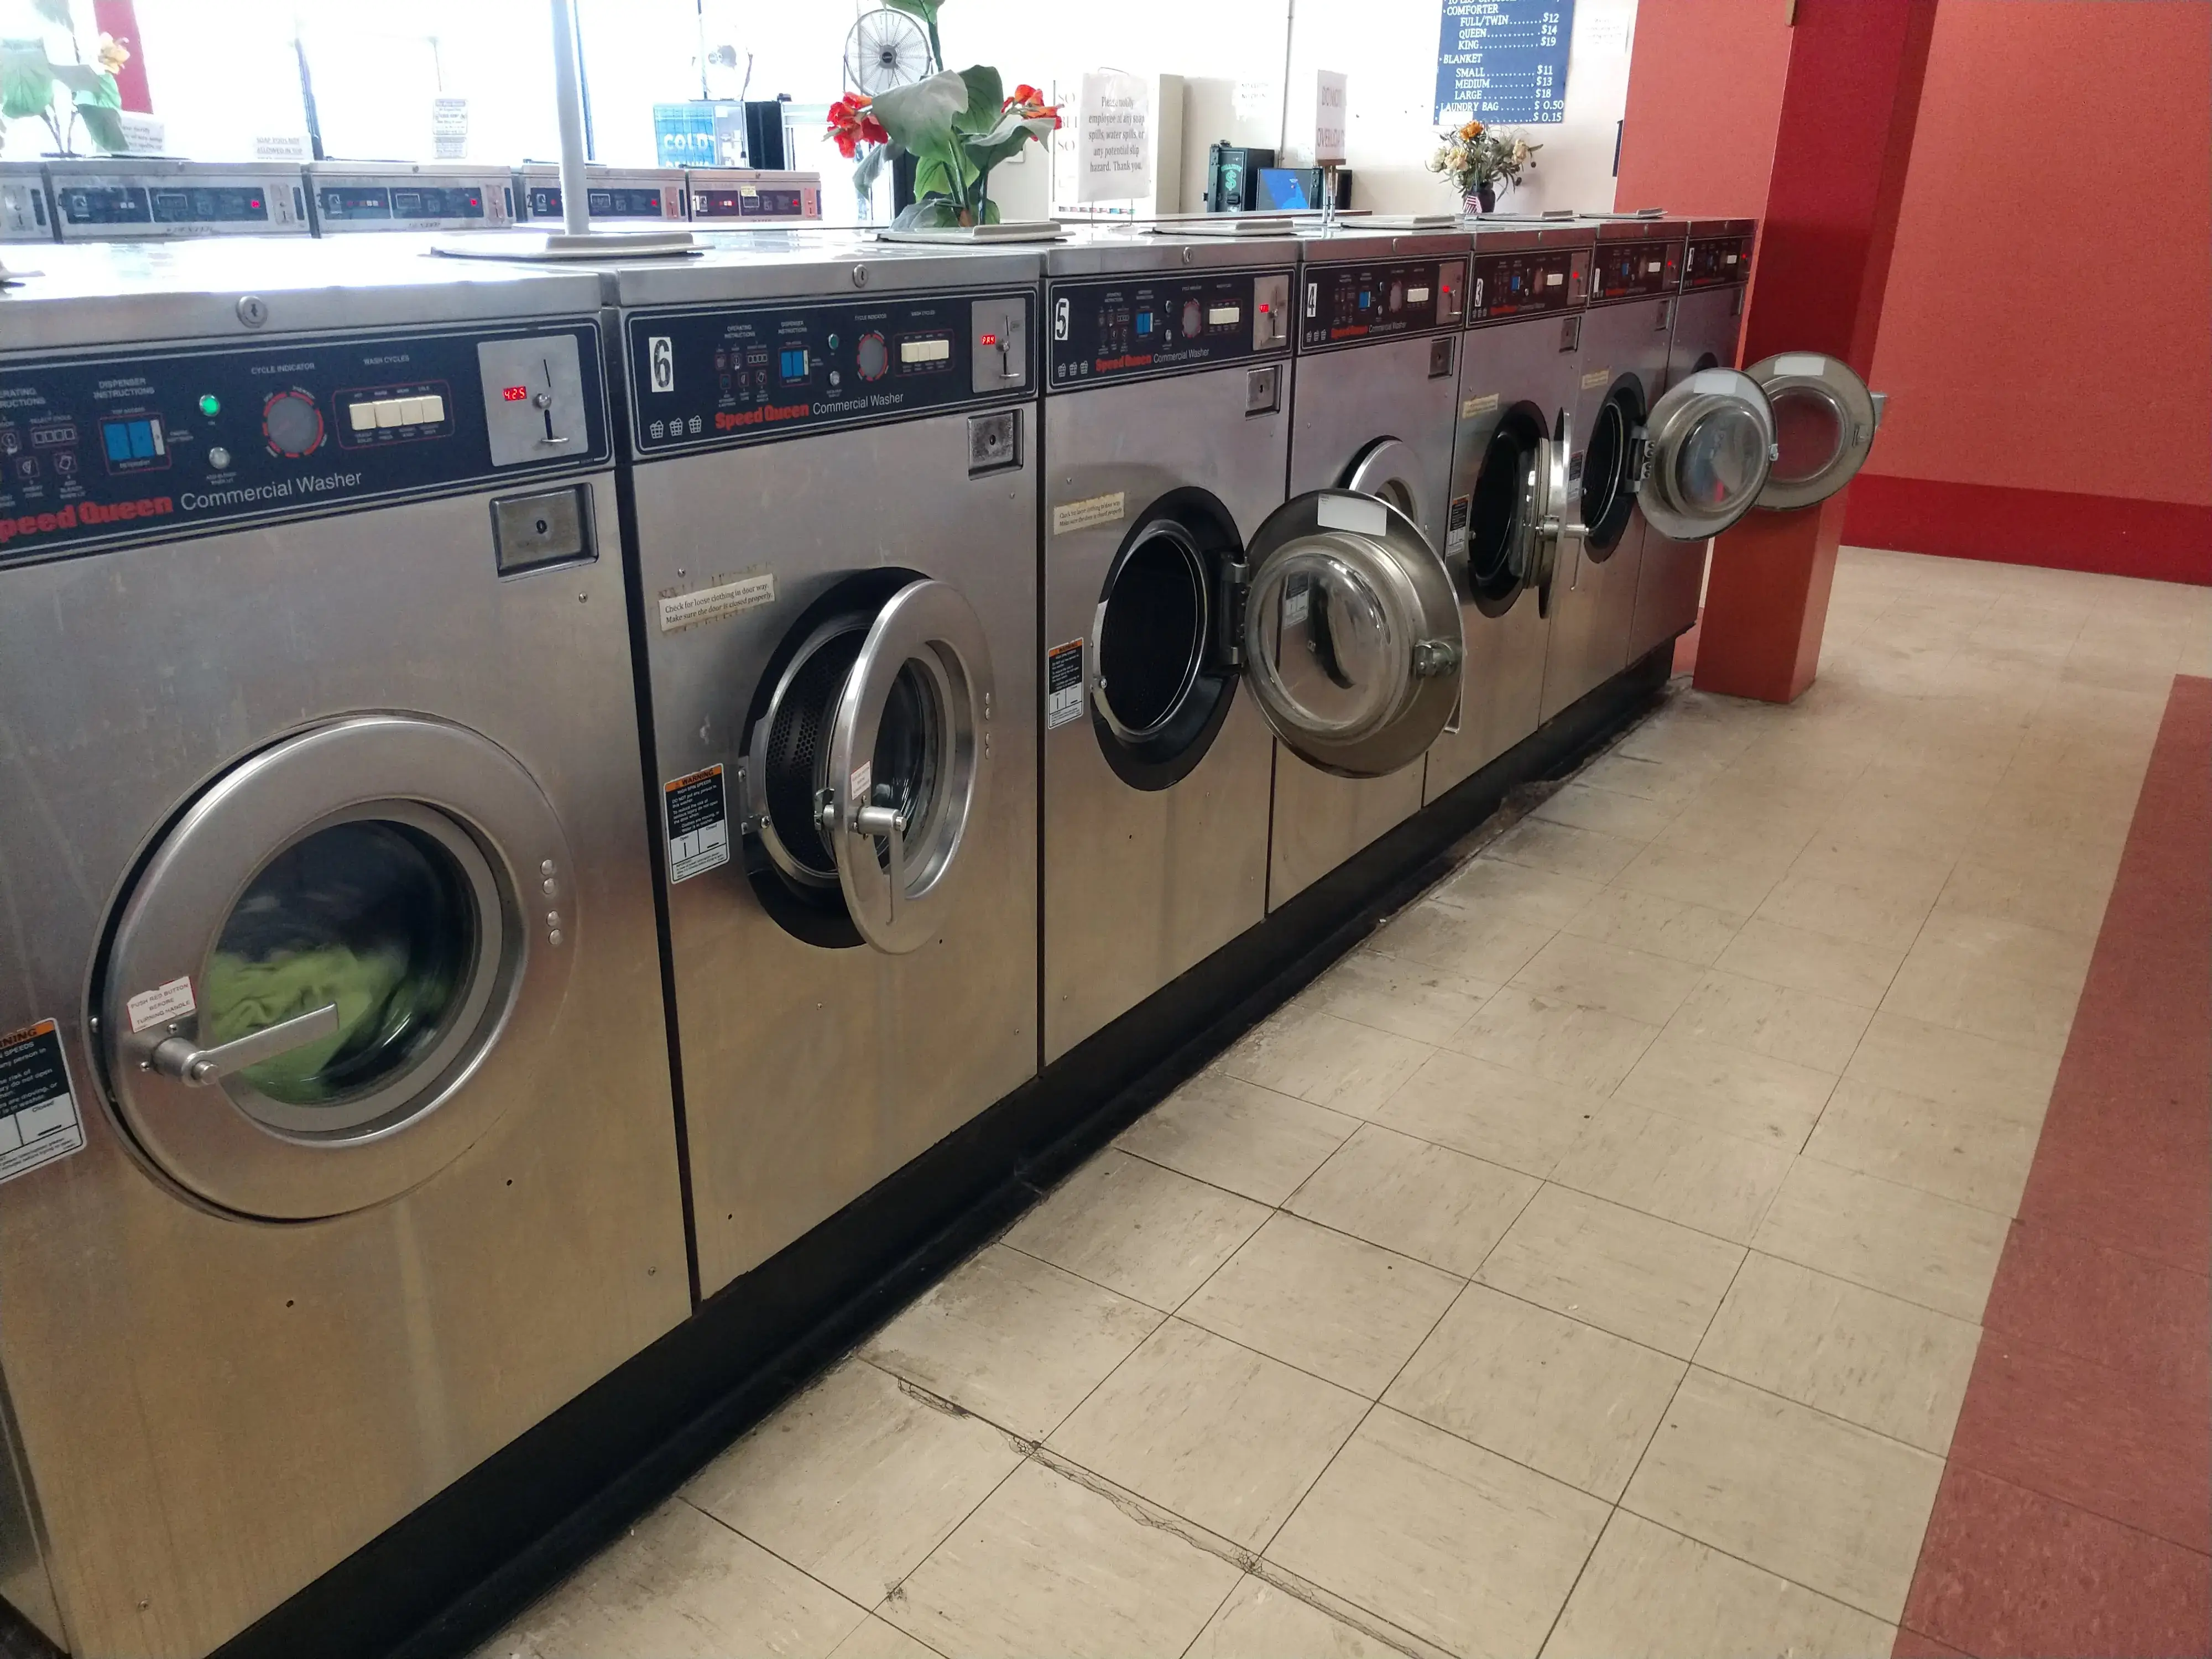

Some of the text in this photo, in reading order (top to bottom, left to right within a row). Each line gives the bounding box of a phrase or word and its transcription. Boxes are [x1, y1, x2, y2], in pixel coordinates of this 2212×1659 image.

[1447, 4, 1498, 15] COMFORTER
[1460, 12, 1559, 27] FULL/TWIN $12
[1459, 25, 1557, 39] QUEEN $14
[1458, 36, 1556, 50] KING $19
[1443, 54, 1483, 64] BLANKET
[1455, 65, 1553, 77] SMALL $11
[1455, 76, 1552, 88] MEDIUM $13
[1454, 88, 1551, 100] LARGE $18
[1441, 102, 1479, 112] LAUNDRY
[1482, 101, 1499, 111] BAG
[1089, 113, 1116, 126] employee
[1133, 115, 1145, 126] soap
[664, 133, 708, 150] COLD
[1106, 130, 1121, 139] water
[1093, 144, 1139, 158] any potential slip
[1091, 161, 1111, 172] hazard.
[1113, 161, 1130, 171] Thank
[1476, 281, 1482, 306] 3
[1309, 286, 1315, 316] 4
[1056, 302, 1067, 338] 5
[384, 355, 409, 363] CYCLES
[1154, 349, 1188, 363] Commercial
[1189, 348, 1209, 358] Washer
[277, 363, 315, 372] INDICATOR
[655, 340, 669, 388] 6
[98, 378, 146, 388] DISPENSER
[93, 387, 155, 399] INSTRUCTIONS
[716, 392, 904, 431] Speed Queen Commercial Washer
[79, 497, 173, 524] Queen
[180, 478, 293, 510] Commercial
[296, 471, 362, 493] Washer
[665, 602, 684, 613] Check
[695, 598, 710, 607] loose
[711, 592, 734, 604] clothing
[742, 587, 755, 595] door
[756, 583, 769, 592] way.
[666, 614, 682, 624] Make
[698, 608, 707, 616] the
[708, 604, 722, 613] door
[729, 599, 747, 608] closed
[748, 592, 773, 604] properly.
[682, 769, 714, 785] WARNING
[131, 999, 148, 1009] PUSH
[164, 984, 188, 996] BUTTON
[149, 998, 174, 1011] BEFORE
[137, 1000, 190, 1024] TURNING HANDLE
[4, 1041, 34, 1056] SPEEDS
[13, 1051, 38, 1064] person
[8, 1072, 22, 1081] risk
[22, 1075, 33, 1083] not
[35, 1068, 53, 1078] open
